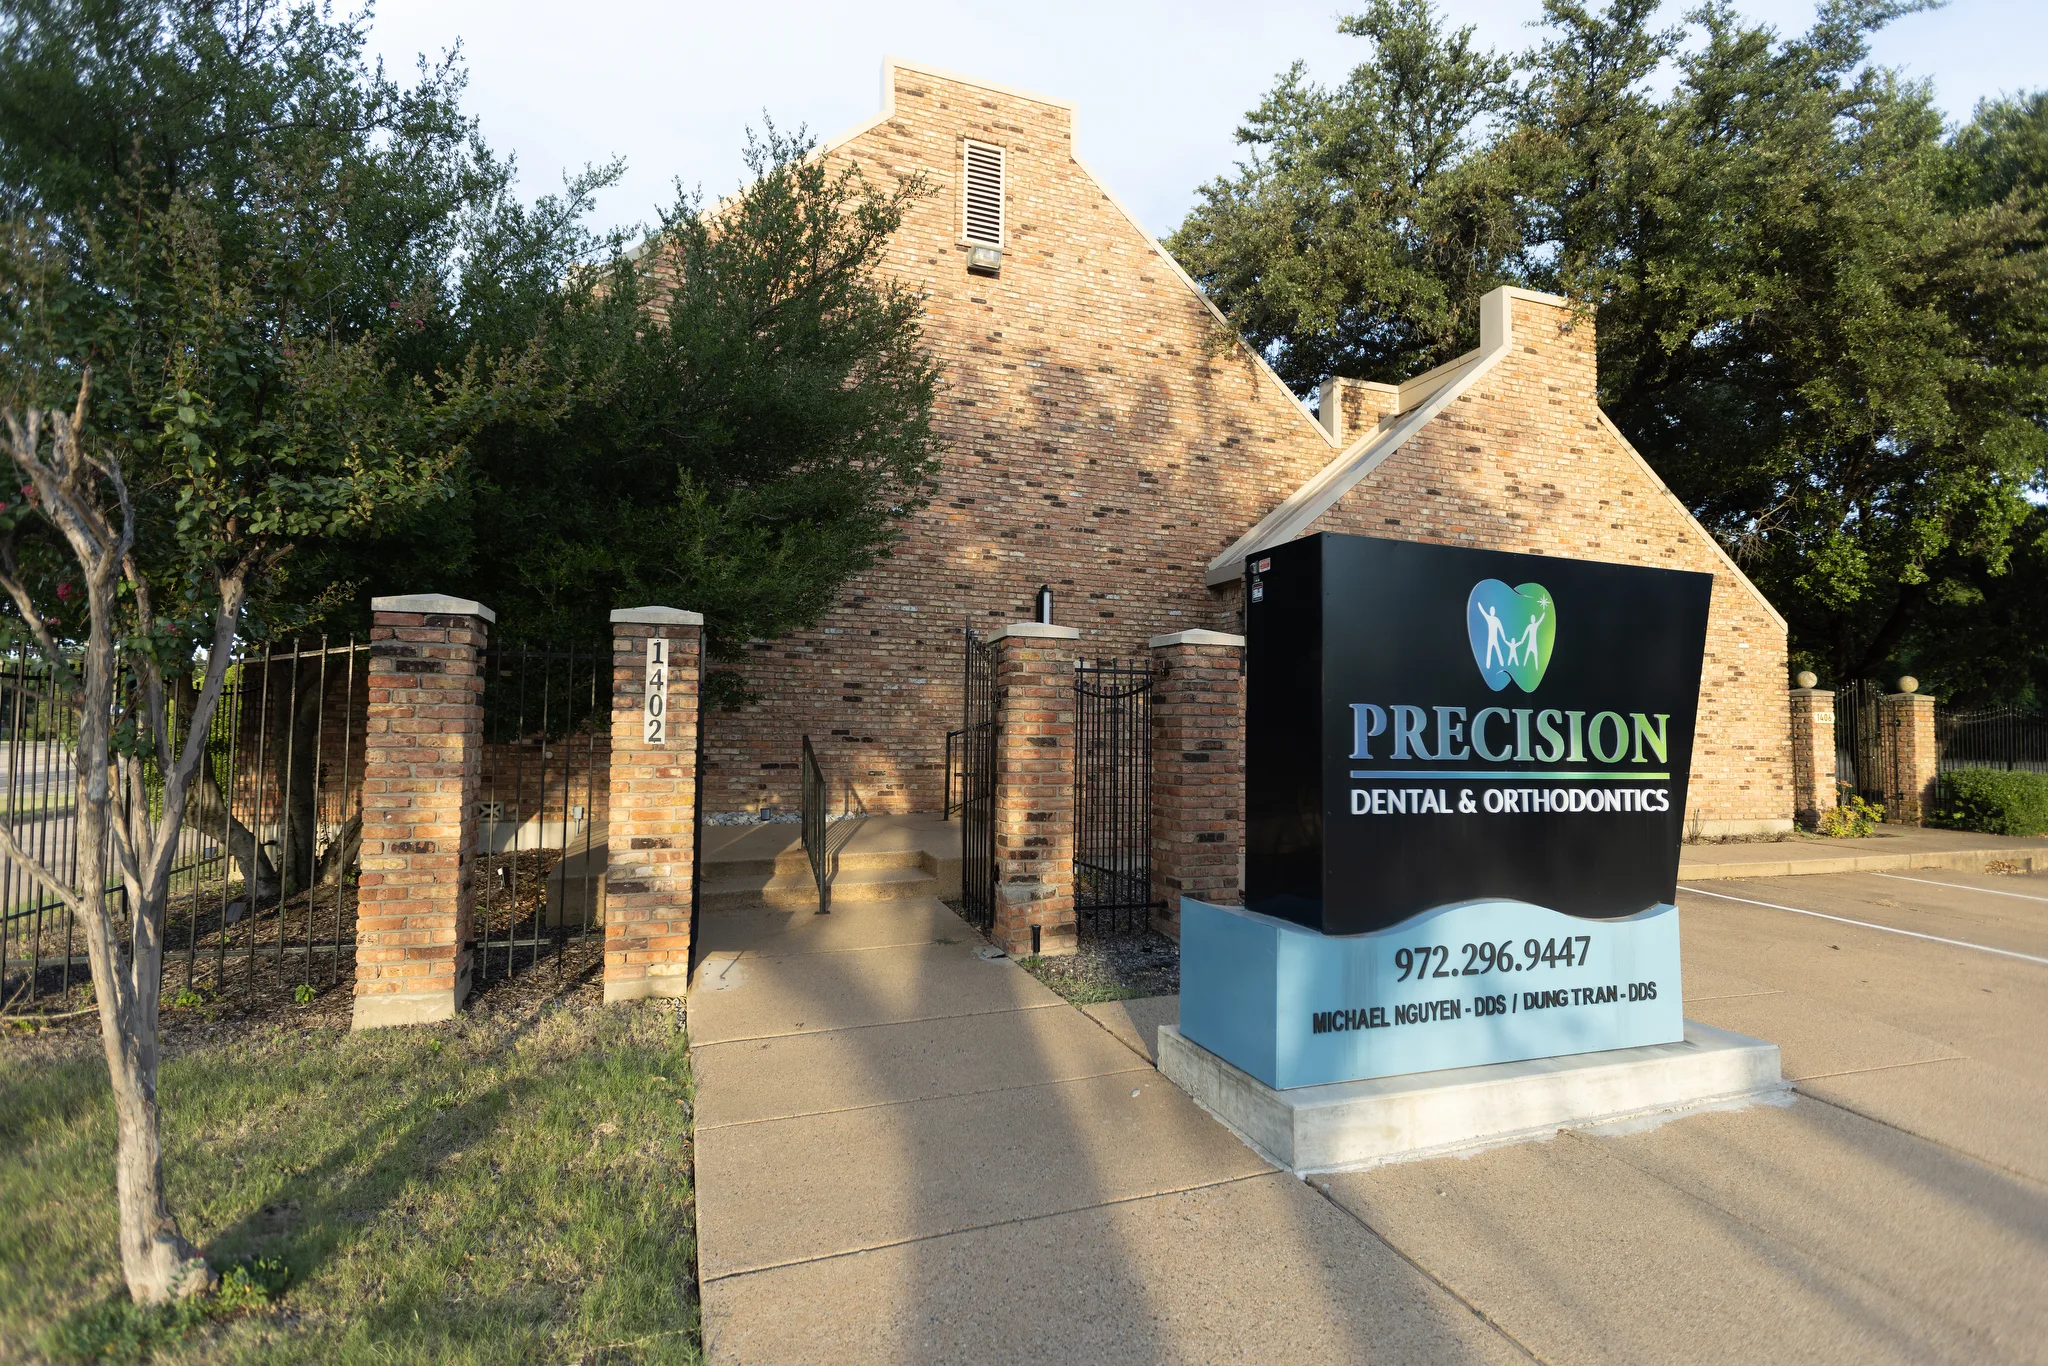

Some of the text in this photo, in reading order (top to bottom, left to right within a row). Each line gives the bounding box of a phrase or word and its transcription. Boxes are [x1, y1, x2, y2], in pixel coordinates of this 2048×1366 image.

[648, 641, 664, 742] 1402
[1348, 703, 1670, 764] PRECISION
[1351, 788, 1669, 815] DENTAL & ORTHODONTICS
[1394, 935, 1591, 982] 972.296.9447
[1312, 1006, 1391, 1034] MICHAEL
[1395, 999, 1462, 1026] NGUYEN
[1474, 994, 1506, 1017] DDS
[1523, 989, 1568, 1010] DUNG
[1571, 985, 1618, 1006] TRAN
[1628, 981, 1658, 1002] DDS
